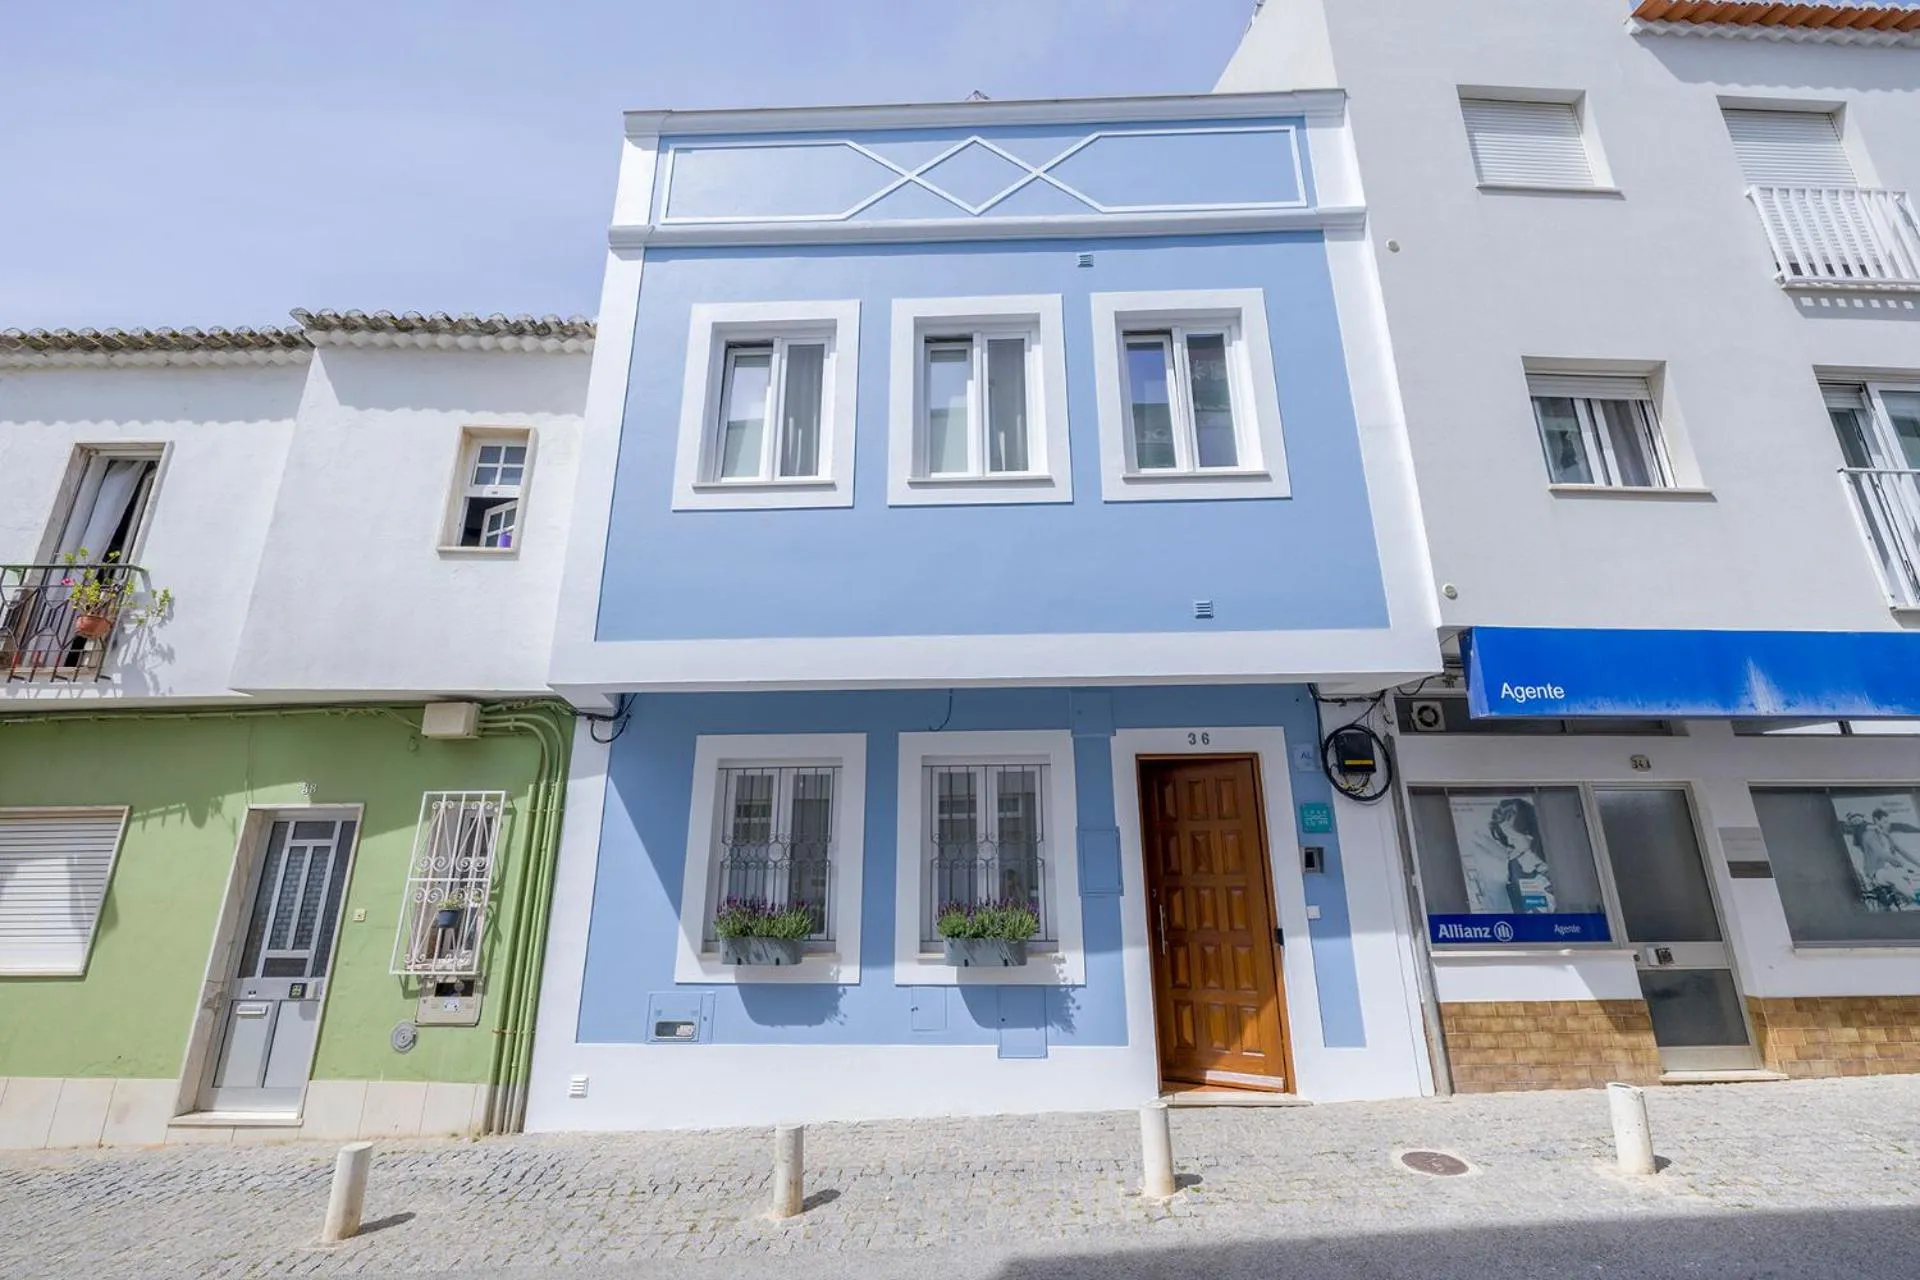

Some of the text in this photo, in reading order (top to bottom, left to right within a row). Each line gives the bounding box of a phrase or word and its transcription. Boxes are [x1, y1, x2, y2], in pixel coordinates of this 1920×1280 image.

[1501, 682, 1565, 703] Agente
[1187, 732, 1210, 746] 36
[1438, 923, 1582, 939] Allianz Agente
